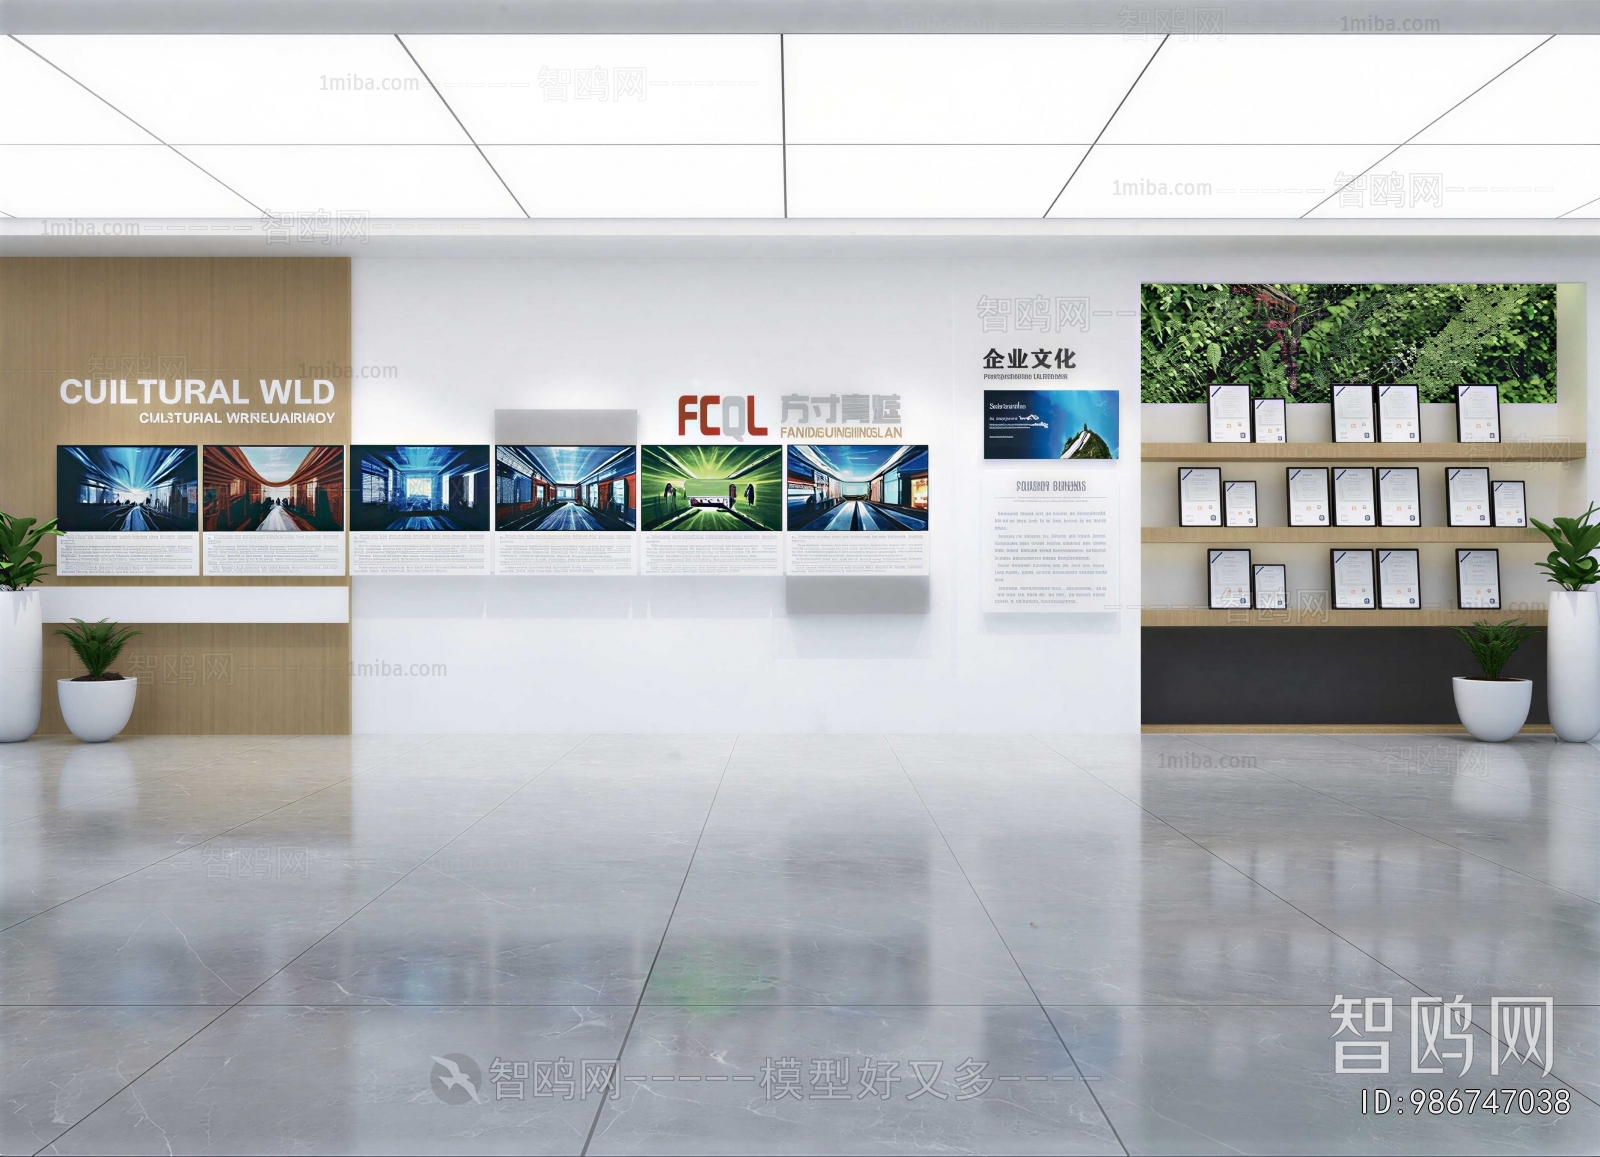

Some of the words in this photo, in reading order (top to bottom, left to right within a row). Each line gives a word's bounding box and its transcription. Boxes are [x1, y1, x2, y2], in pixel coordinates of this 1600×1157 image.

[983, 348, 1076, 369] 企业文化
[59, 379, 249, 405] CUILTURAL
[260, 379, 335, 405] WLD
[678, 395, 768, 442] FCQL
